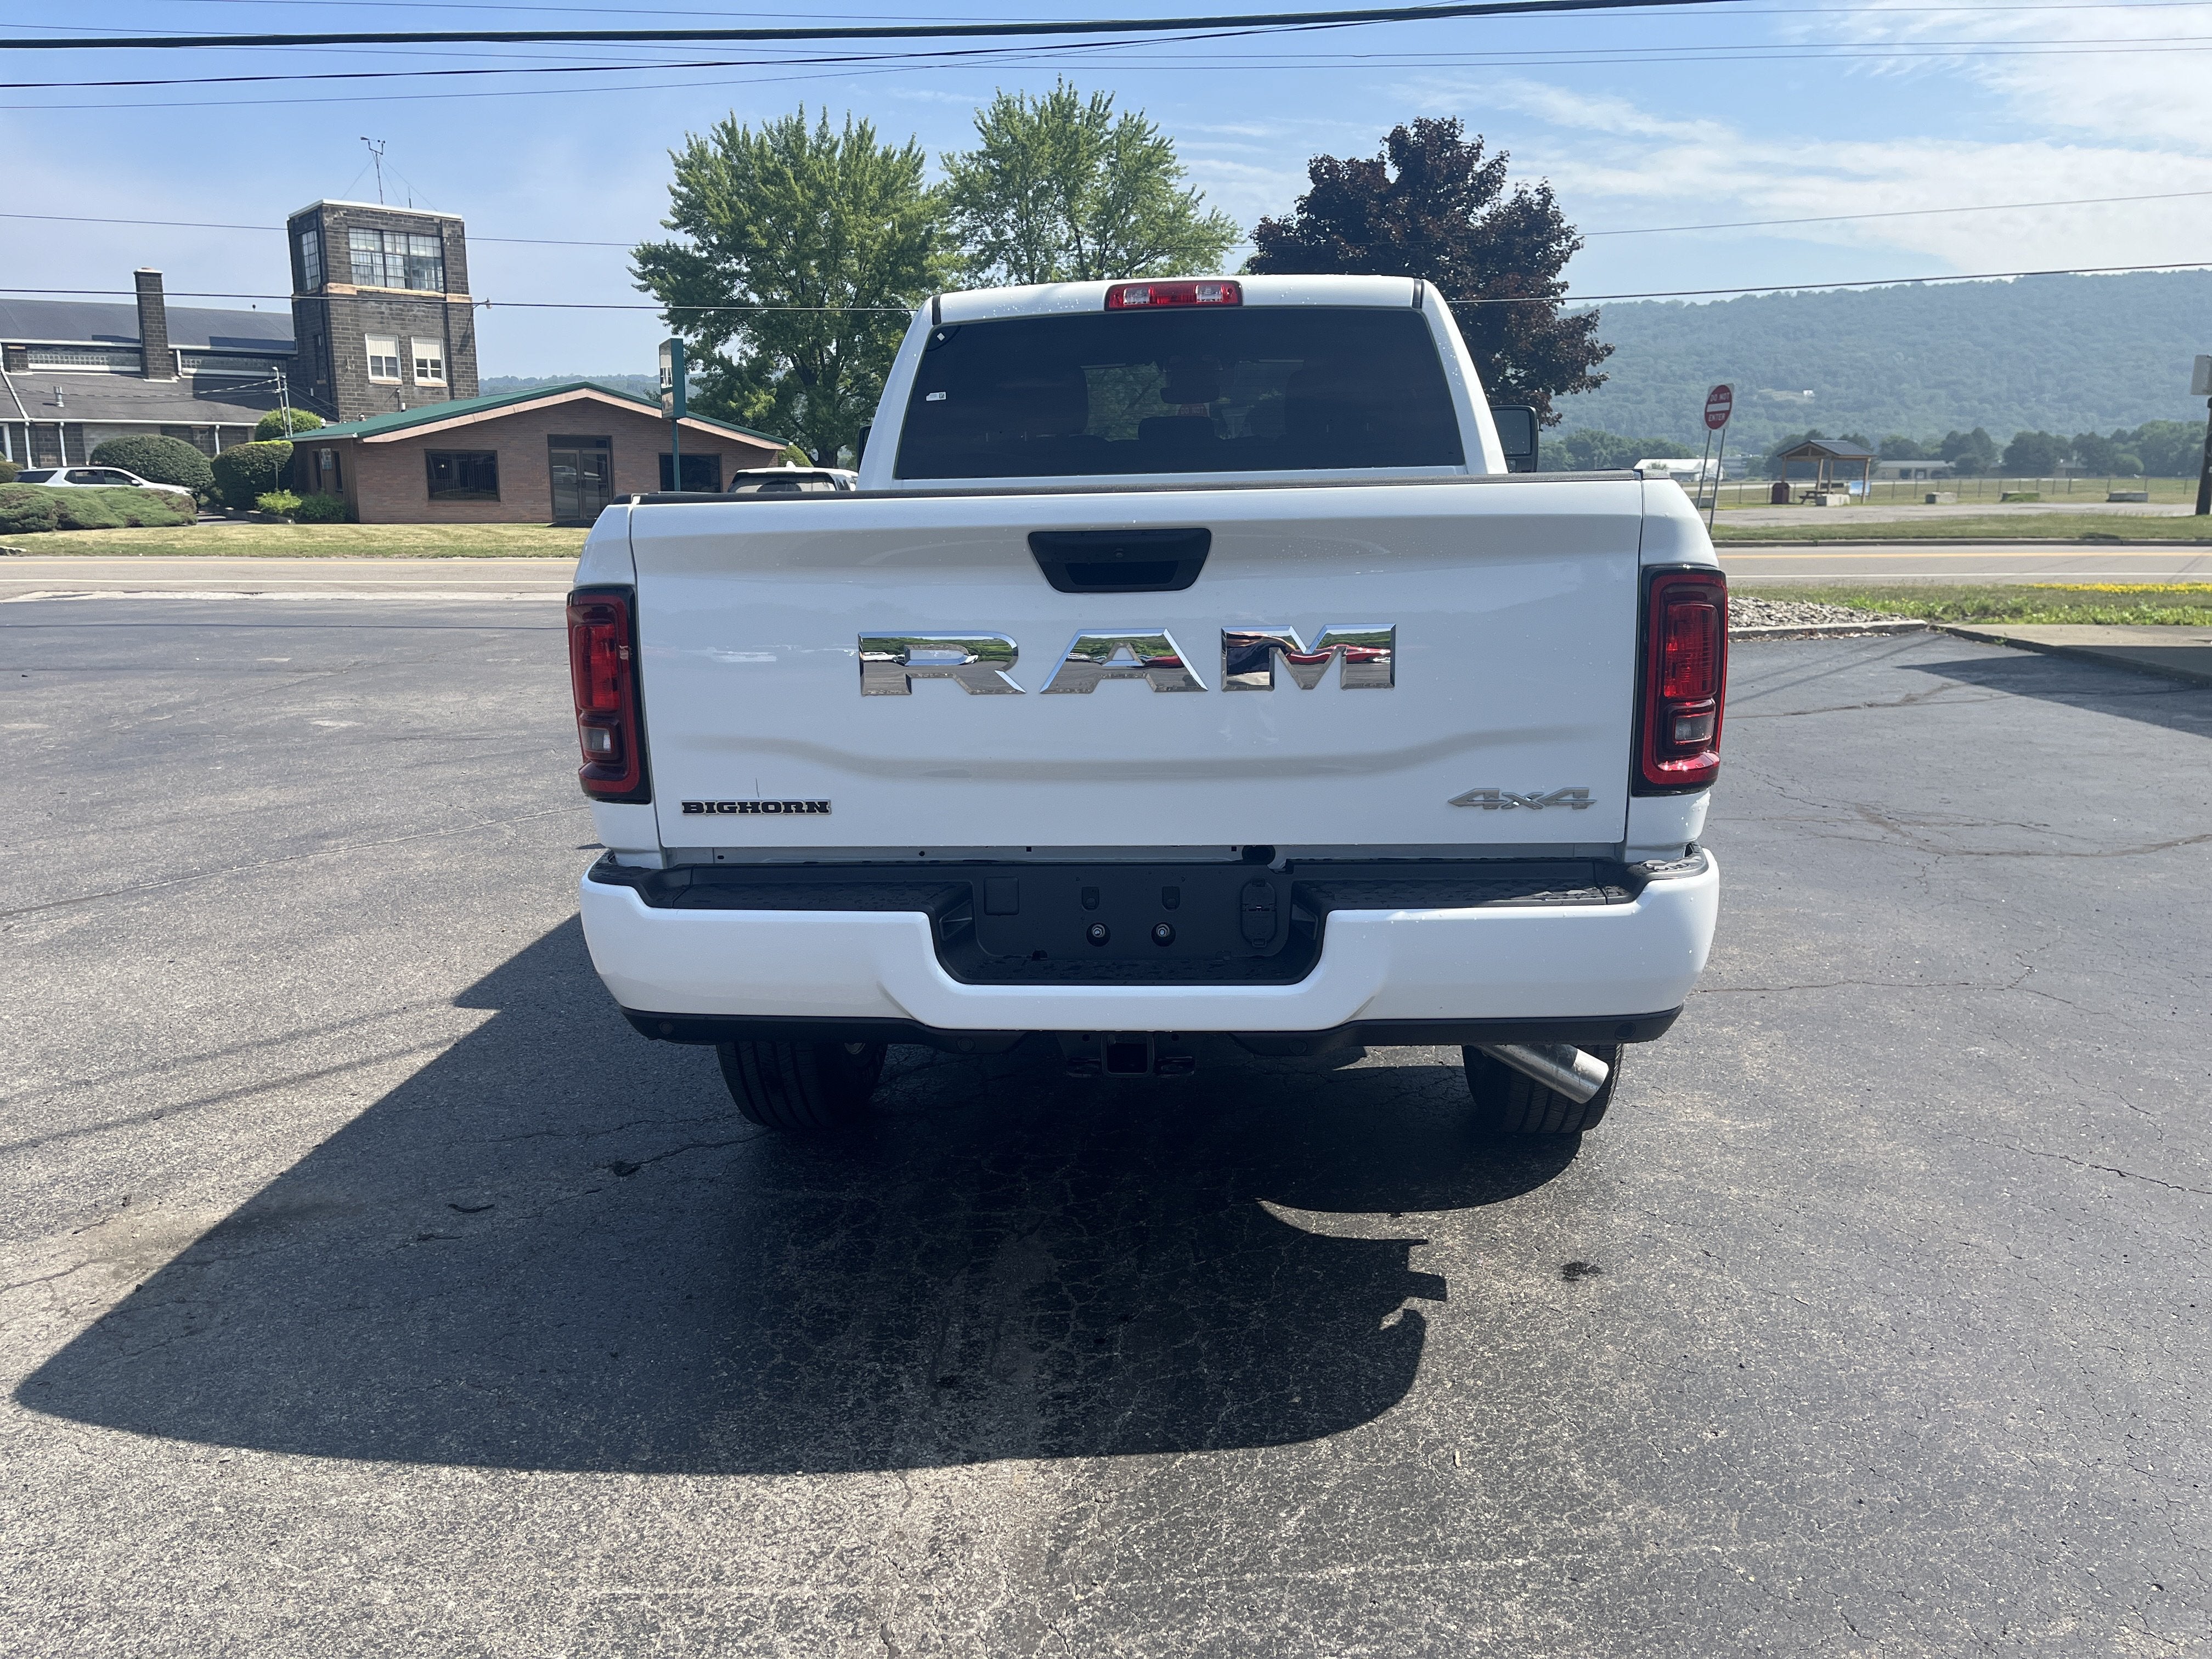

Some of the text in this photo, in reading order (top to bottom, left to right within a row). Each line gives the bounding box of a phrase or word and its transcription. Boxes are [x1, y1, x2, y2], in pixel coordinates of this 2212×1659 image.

[1710, 392, 1730, 402] DO NOT
[1708, 413, 1726, 422] ENTER
[857, 623, 1396, 696] RAM
[681, 799, 832, 816] BIGHORN
